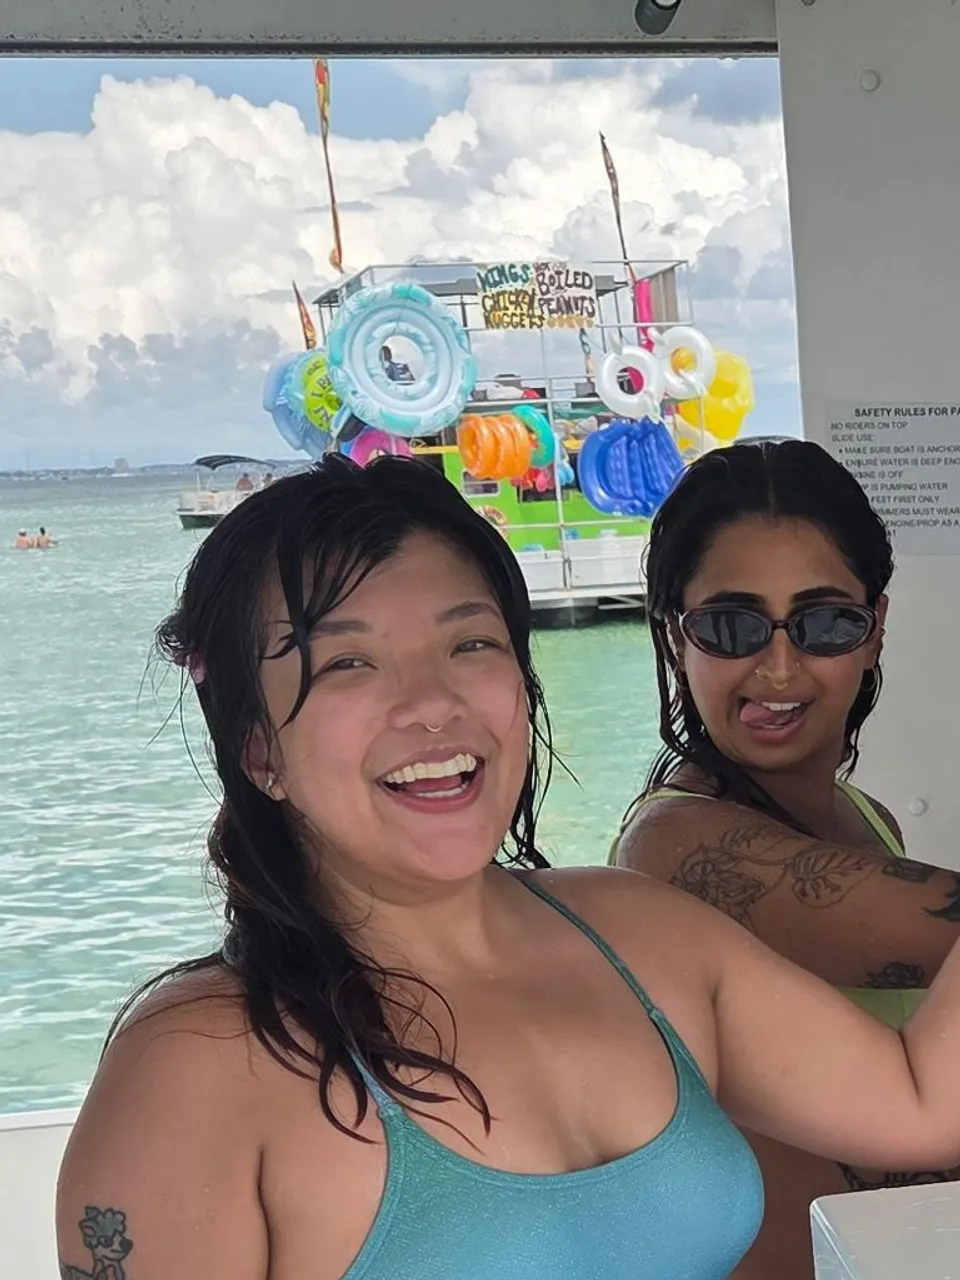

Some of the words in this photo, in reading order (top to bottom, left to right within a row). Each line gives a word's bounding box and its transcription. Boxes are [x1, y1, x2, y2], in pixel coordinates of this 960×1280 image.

[477, 264, 531, 292] WINGS
[536, 269, 593, 296] BOILED
[538, 295, 596, 318] PEANUTS
[483, 312, 545, 329] NUGGETS
[854, 407, 892, 418] SAFETY
[894, 407, 926, 417] RULES
[928, 406, 949, 417] FOR
[831, 422, 843, 431] NO
[877, 421, 890, 430] ON
[891, 421, 908, 429] TOP
[893, 445, 915, 454] BOAT
[880, 458, 909, 467] WATER
[920, 457, 942, 466] DEEP
[919, 482, 948, 491] WATER
[912, 507, 935, 516] MUST
[936, 507, 960, 516] WEAR
